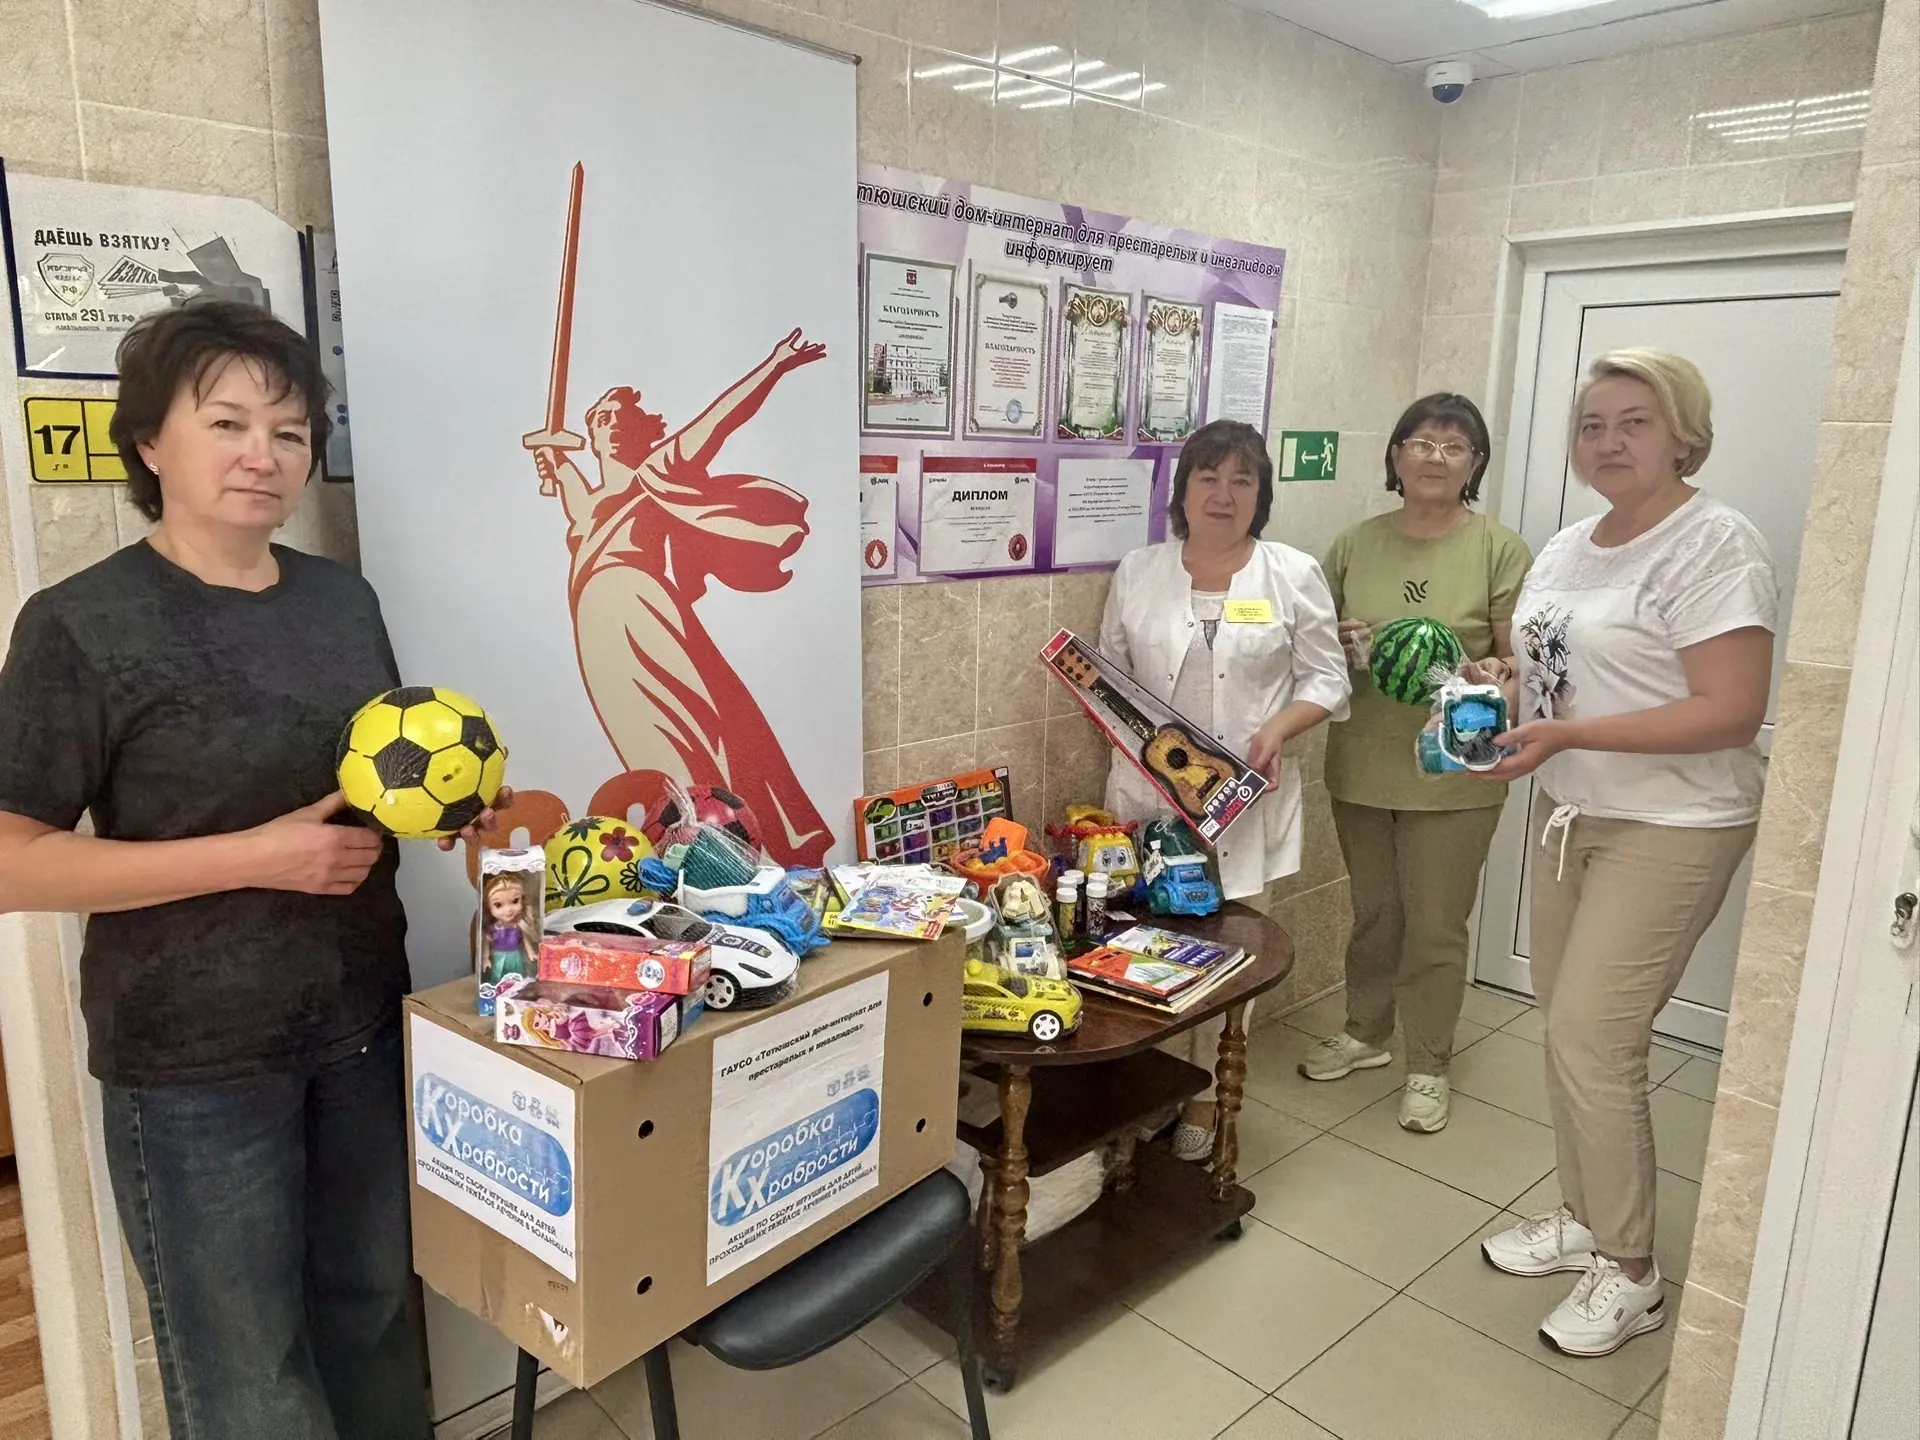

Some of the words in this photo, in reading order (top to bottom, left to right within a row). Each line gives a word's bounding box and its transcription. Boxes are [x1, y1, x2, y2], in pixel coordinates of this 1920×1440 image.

[34, 228, 93, 247] ДАЁШЬ
[99, 233, 170, 251] ВЗЯТКУ?
[954, 196, 1075, 239] дом-интернат
[1078, 222, 1104, 245] для
[1108, 232, 1197, 263] престарелых
[1200, 251, 1208, 263] и
[1211, 251, 1280, 276] инвалидов»
[107, 260, 158, 284] ВЗЯТКА
[1005, 239, 1113, 272] информирует
[44, 311, 78, 321] СТАТЬЯ
[80, 308, 105, 322] 291
[108, 314, 120, 322] УК
[883, 305, 940, 318] БЛАГОДАРНОСТЬ
[985, 343, 1037, 354] БЛАГОДАРНОСТЬ
[34, 425, 80, 455] 17
[952, 490, 1008, 502] ДИПЛОМ
[720, 1057, 752, 1078] ГАУСО
[811, 1008, 867, 1037] дом-интернат
[868, 1000, 882, 1012] для
[749, 1050, 807, 1081] престарелых
[808, 1045, 814, 1054] и
[422, 1079, 522, 1146] Коробка
[442, 1114, 551, 1204] Храбрости
[717, 1112, 835, 1220] Коробка
[742, 1136, 859, 1217] Храбрости
[454, 1168, 465, 1180] ПО
[520, 1209, 535, 1222] ДЛЯ
[727, 1225, 754, 1245] АКЦИЯ
[756, 1218, 768, 1230] ПО
[770, 1203, 794, 1222] СБОРУ
[827, 1175, 842, 1189] ДЛЯ
[708, 1227, 767, 1265] ПРОХОДЯЩИХ
